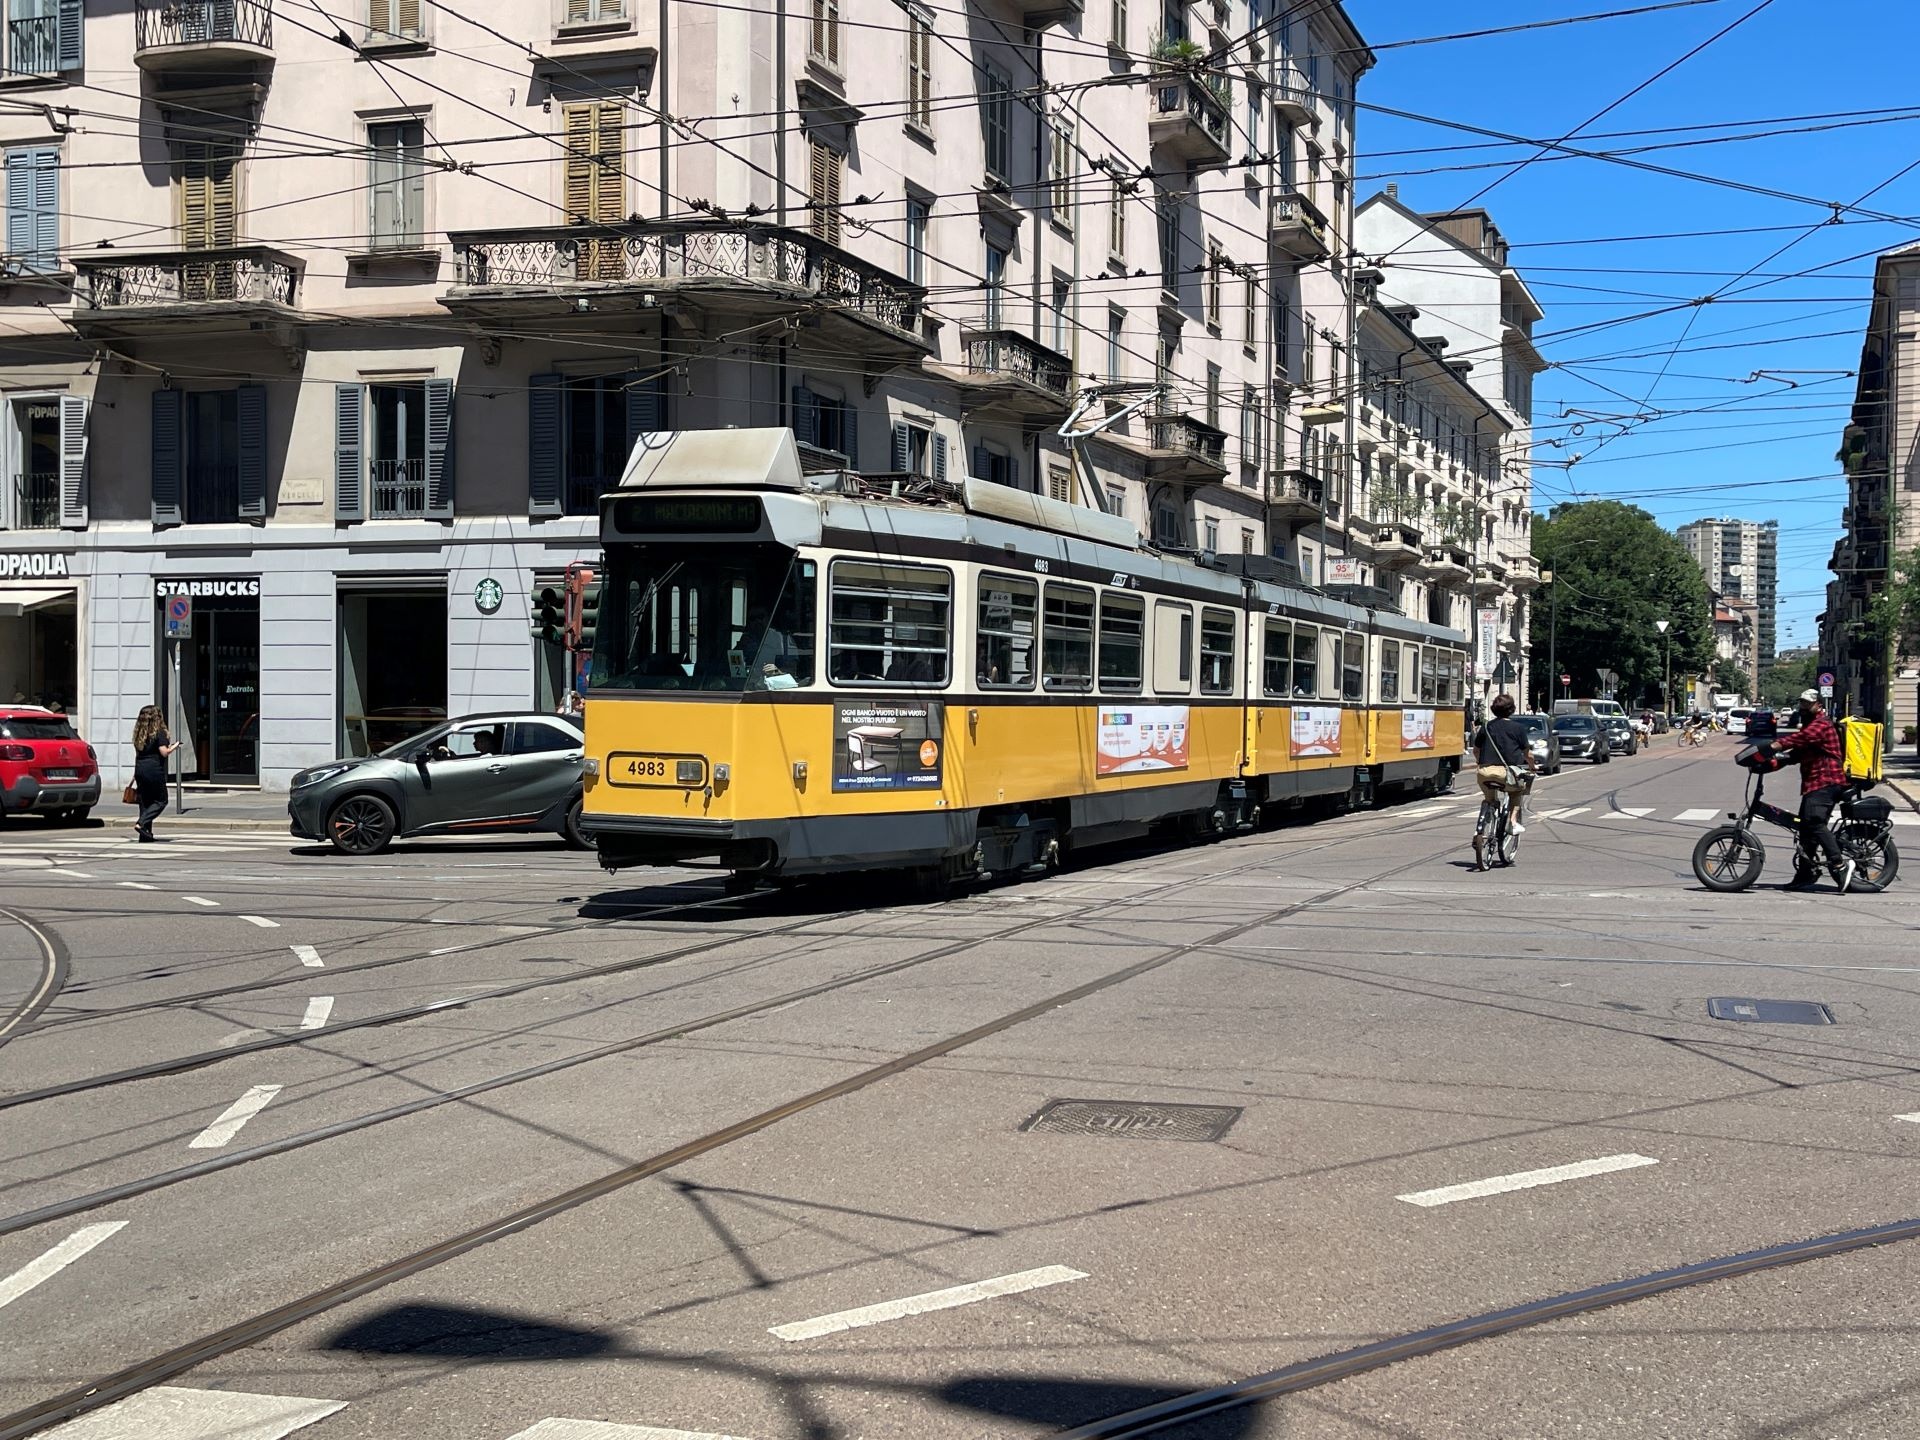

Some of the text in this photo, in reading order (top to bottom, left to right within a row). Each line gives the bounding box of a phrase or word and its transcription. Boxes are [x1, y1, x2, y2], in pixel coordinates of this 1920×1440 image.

[157, 581, 259, 596] STARBUCKS
[876, 709, 895, 717] VUOTO
[628, 761, 665, 776] 4983
